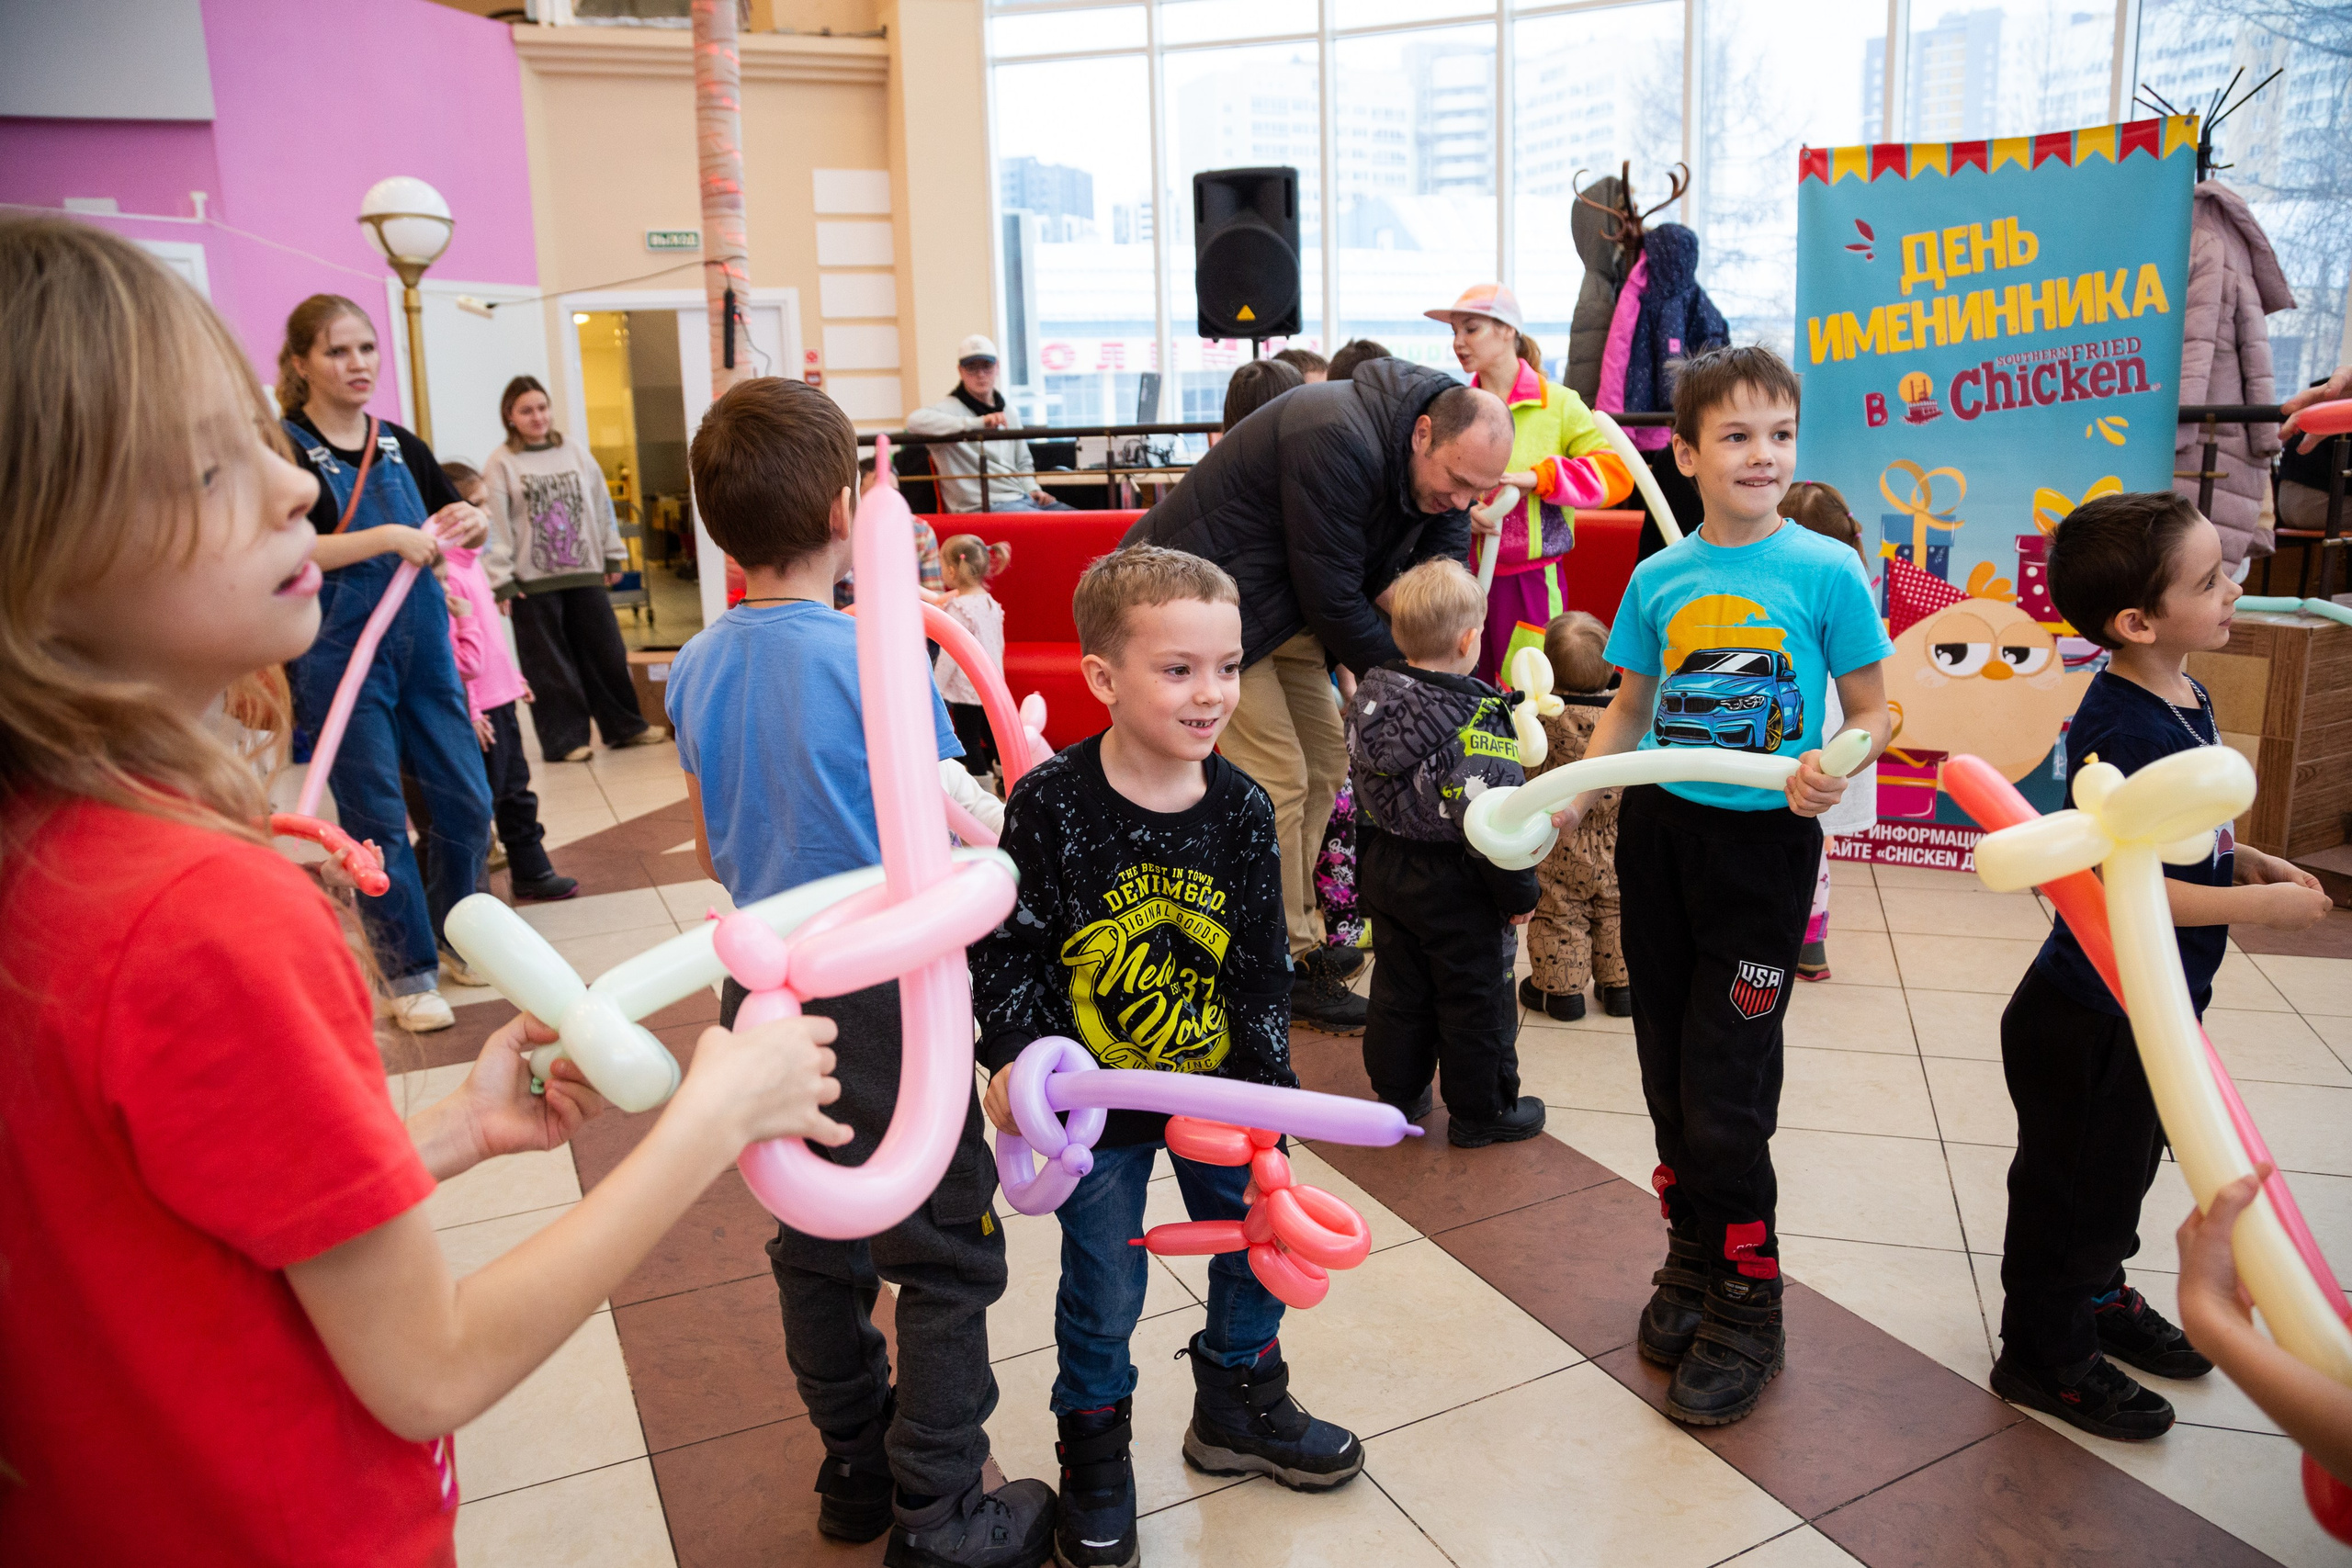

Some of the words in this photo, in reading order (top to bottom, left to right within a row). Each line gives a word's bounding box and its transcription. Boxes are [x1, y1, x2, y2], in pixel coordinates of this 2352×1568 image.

[1900, 216, 2040, 296] ДЕНЬ
[1807, 263, 2170, 365] ИМЕНИННИКА
[1996, 346, 2068, 367] SOUTHERN
[2071, 336, 2142, 362] FRIED
[1950, 356, 2151, 421] Chicken
[1864, 392, 1889, 427] В
[1826, 838, 1872, 859] АЙТЕ
[1869, 824, 1987, 850] ИНФОРМАЦИ
[1118, 866, 1138, 881] THE
[1141, 863, 1168, 875] BEST
[1172, 868, 1183, 878] IN
[1188, 870, 1214, 886] TOWN
[1102, 874, 1226, 915] DENIM&CO.
[1177, 913, 1219, 944] GOODS
[1077, 921, 1176, 997] New
[1741, 964, 1781, 987] USA
[1117, 991, 1223, 1062] York
